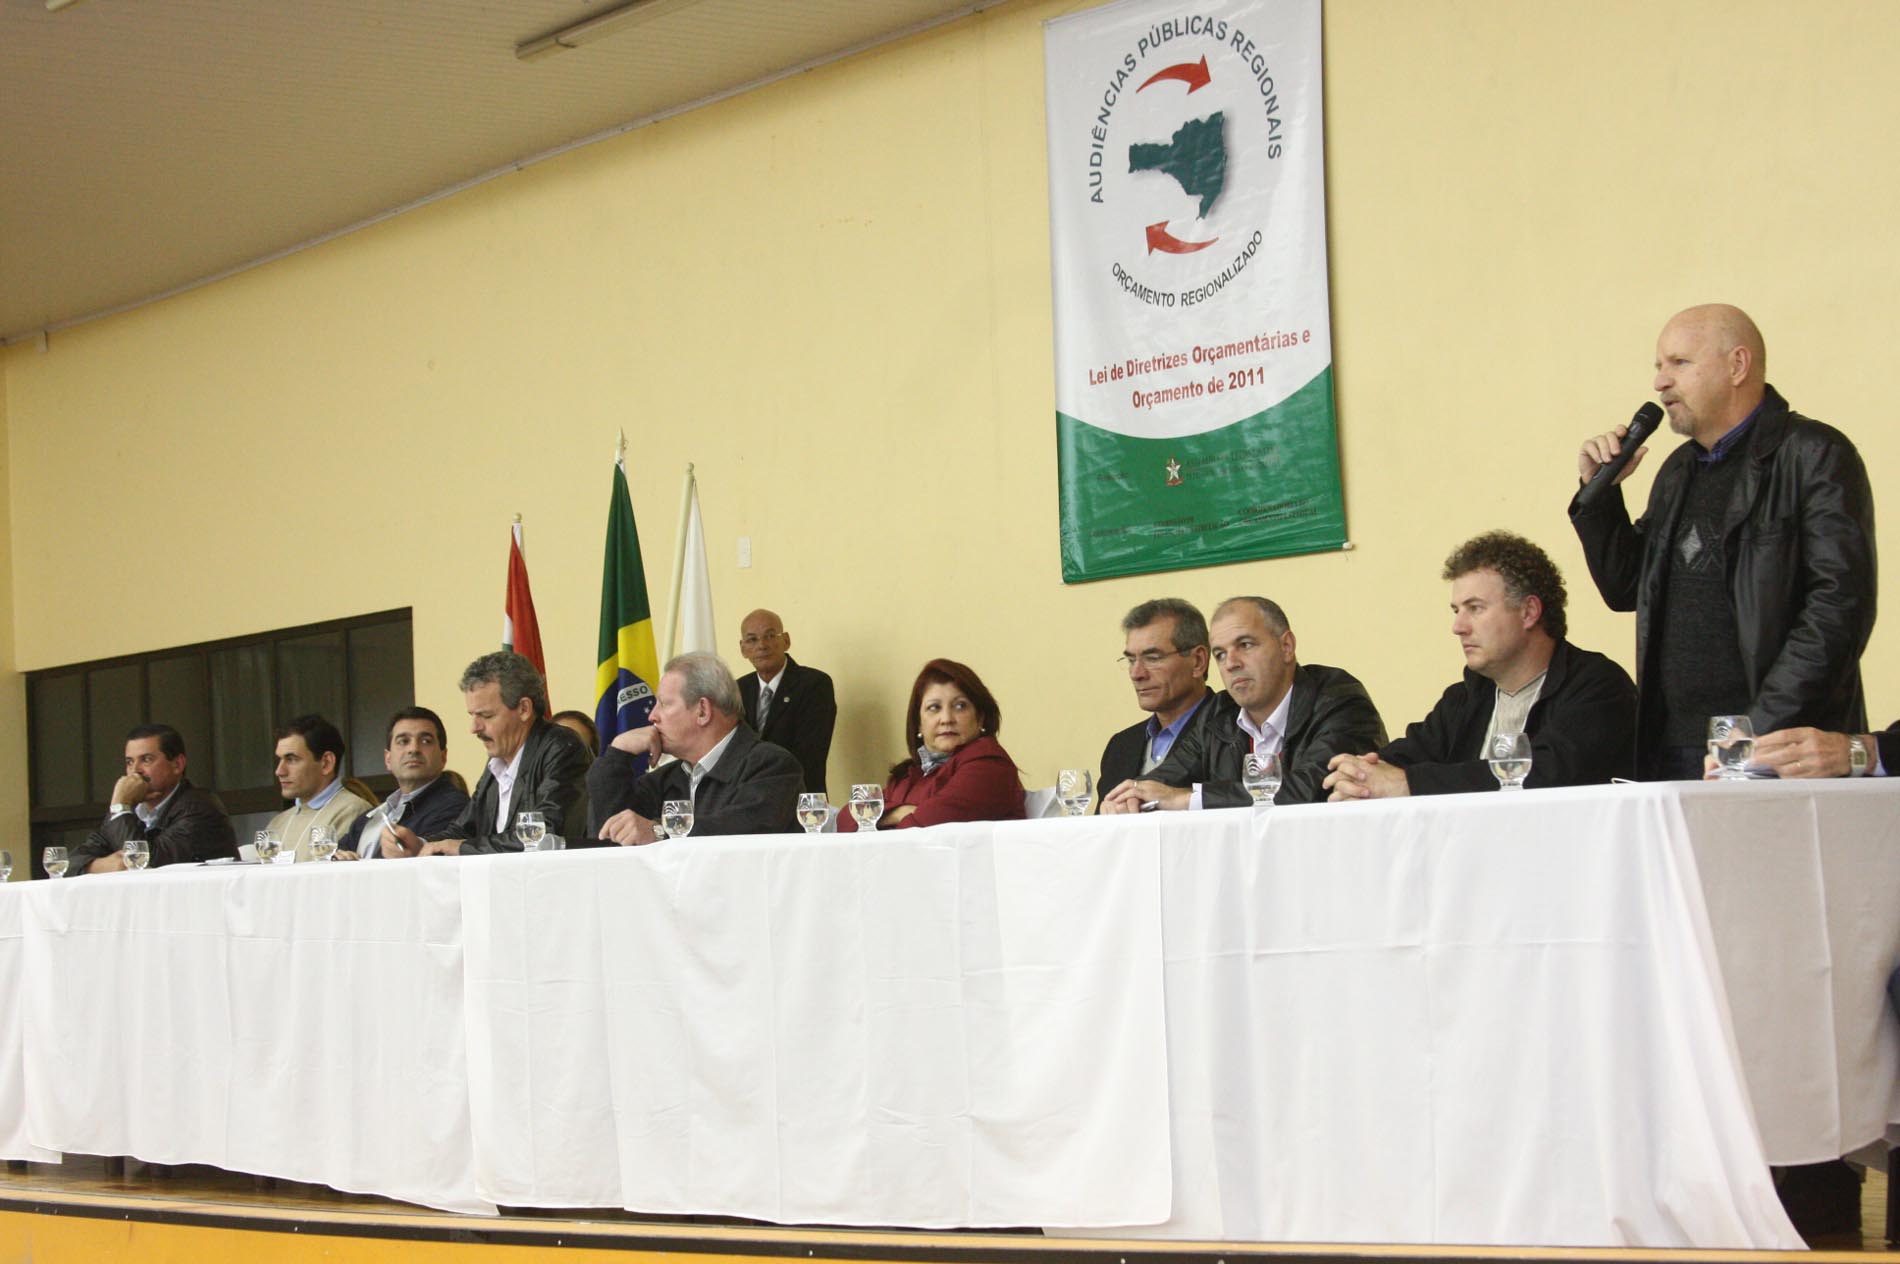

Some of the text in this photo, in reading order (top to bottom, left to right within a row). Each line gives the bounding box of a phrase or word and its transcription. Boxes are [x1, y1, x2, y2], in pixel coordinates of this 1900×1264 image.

[1089, 15, 1282, 204] AUDIÊNCIAS PÚBLICAS REGIONAIS
[1112, 230, 1263, 308] ORÇAMENTO REGIONALIZADO
[1089, 329, 1311, 386] Lei de Diretrizes Orçamentárias e
[1132, 367, 1266, 411] Orçamento de 2011
